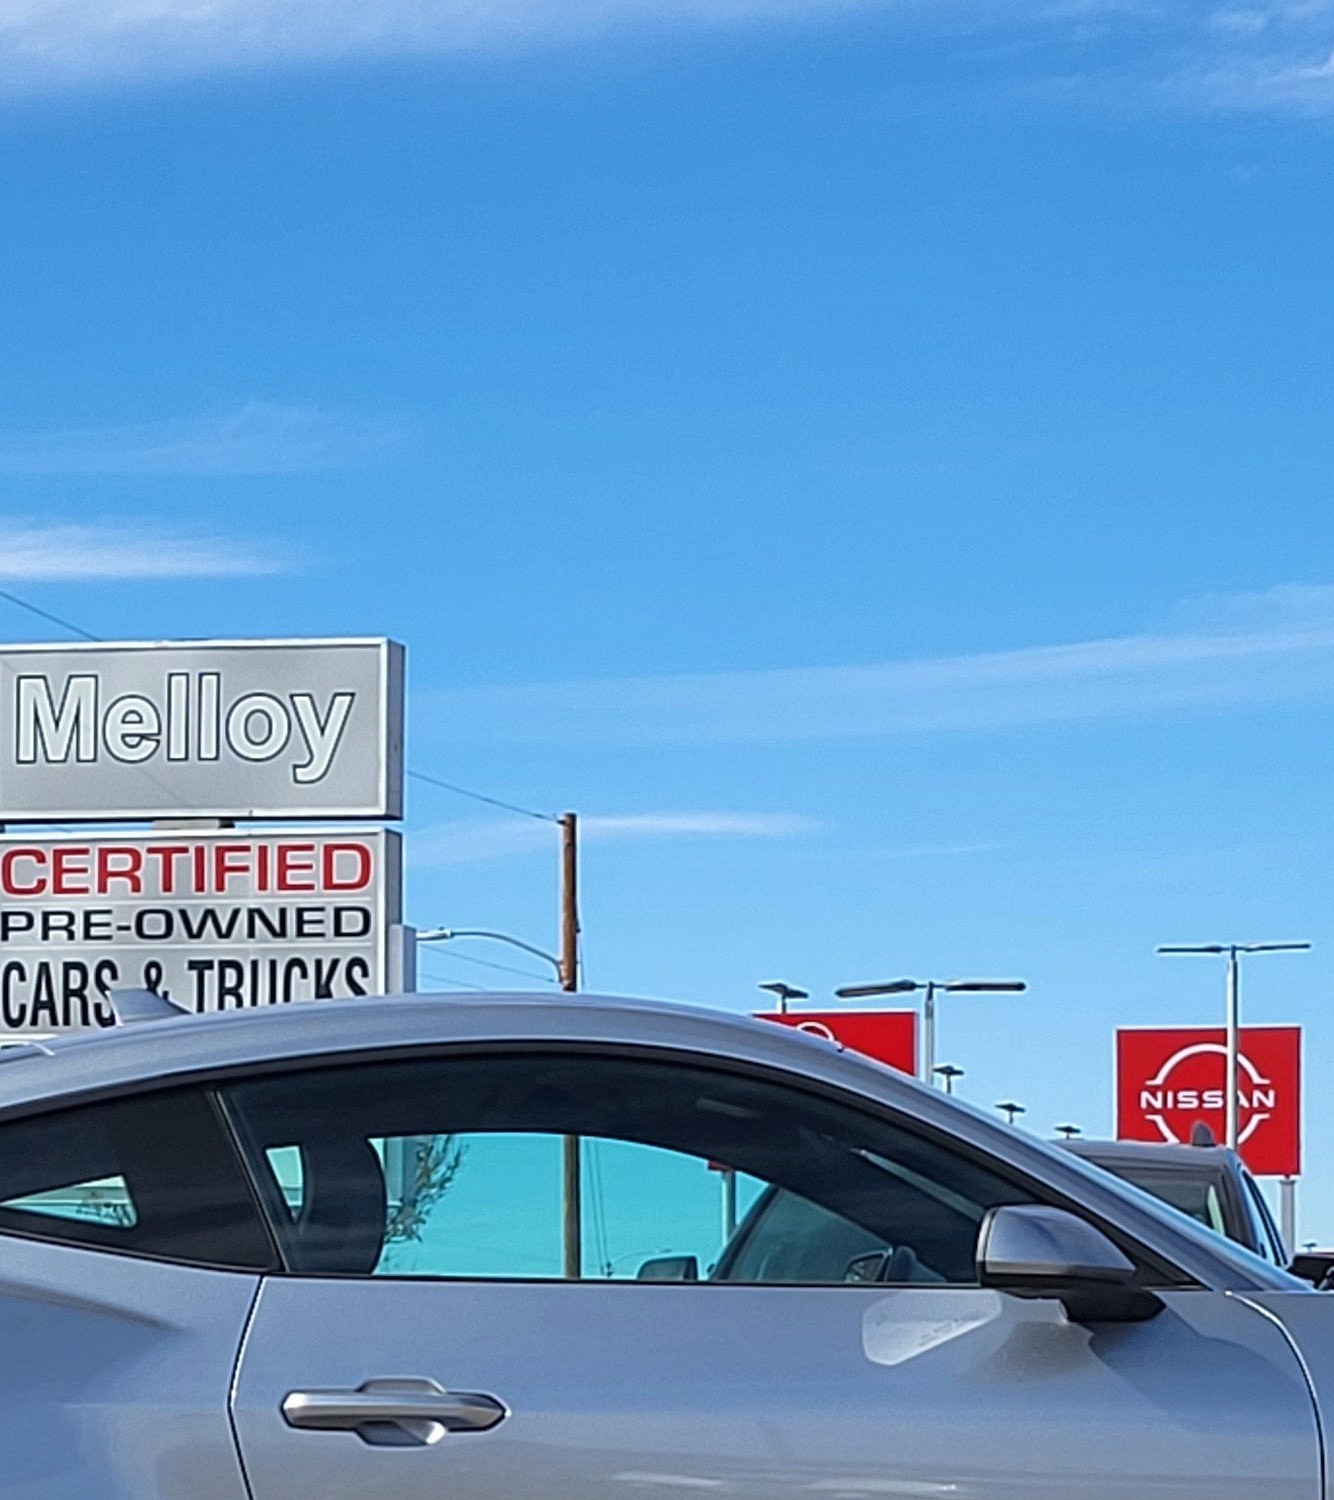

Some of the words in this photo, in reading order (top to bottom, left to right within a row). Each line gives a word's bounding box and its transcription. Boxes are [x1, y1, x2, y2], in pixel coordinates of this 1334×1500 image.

[15, 672, 356, 783] Melloy
[0, 843, 372, 896] CERTIFIED
[0, 906, 372, 941] PRE-OWNED
[2, 959, 120, 1028] CARS
[187, 957, 370, 1015] TRUCKS
